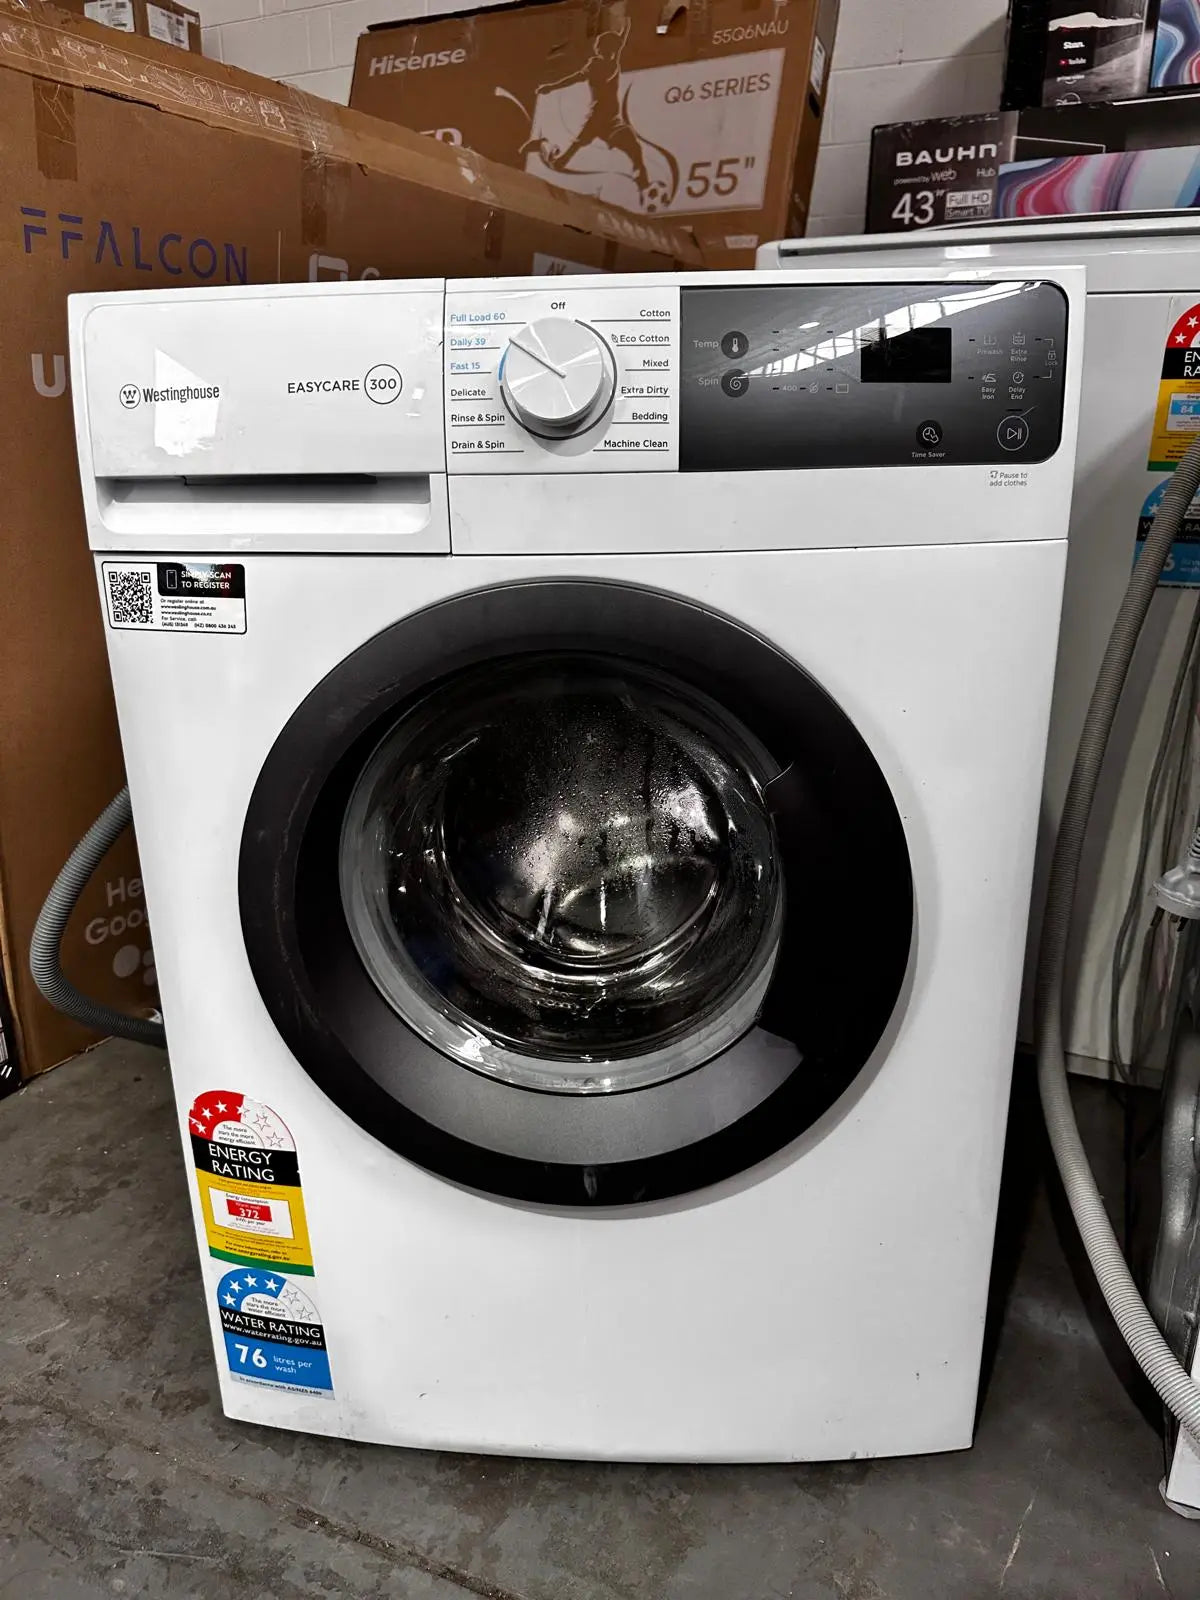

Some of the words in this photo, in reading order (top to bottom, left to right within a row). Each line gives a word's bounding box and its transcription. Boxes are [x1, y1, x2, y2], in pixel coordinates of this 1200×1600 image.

[712, 19, 790, 45] 55Q6NAU
[368, 48, 467, 77] Hisense
[664, 85, 696, 104] Q6
[700, 73, 771, 100] SERIES
[976, 167, 996, 177] Hub
[685, 156, 756, 199] 55"
[949, 194, 969, 206] Full
[972, 192, 989, 203] HD
[947, 208, 974, 218] Smart
[976, 206, 990, 216] TV
[20, 206, 249, 285] FFALCON
[550, 302, 566, 310] Off
[450, 314, 466, 322] Full
[468, 313, 491, 322] Load
[493, 312, 505, 320] 60
[640, 309, 671, 318] Cotton
[450, 338, 473, 347] Daily
[475, 338, 486, 346] 39
[620, 335, 638, 343] Eco
[639, 334, 670, 343] Cotton
[693, 340, 720, 349] Temp
[450, 362, 469, 370] Fast
[471, 362, 480, 370] 15
[643, 359, 669, 368] Mixed
[287, 379, 360, 394] EASYCARE
[370, 378, 397, 391] 300
[698, 377, 719, 386] Spin
[143, 385, 220, 403] Westinghouse
[450, 388, 486, 397] Delicate
[621, 387, 645, 395] Extra
[647, 386, 669, 396] Dirty
[981, 387, 996, 395] Easy
[1008, 386, 1026, 394] Delay
[451, 414, 476, 422] Rinse
[477, 414, 484, 422] &
[485, 413, 505, 424] Spin
[632, 413, 668, 423] Bedding
[451, 441, 477, 449] Drain
[479, 441, 484, 449] &
[485, 441, 505, 451] Spin
[604, 440, 645, 449] Machine
[646, 440, 668, 449] Clean
[1000, 472, 1019, 480] Pause
[210, 571, 232, 579] SCAN
[85, 907, 150, 945] Goo
[208, 1142, 272, 1165] ENERGY
[211, 1159, 275, 1182] RATING
[225, 1193, 240, 1201] Energy
[241, 1196, 269, 1204] consumption
[239, 1208, 260, 1219] 372
[264, 1310, 286, 1318] efficient
[220, 1309, 266, 1330] WATER
[269, 1321, 320, 1338] RATING
[223, 1322, 322, 1346] www.waterrating.gov.au
[234, 1343, 267, 1368] 76
[273, 1355, 295, 1366] litres
[297, 1359, 312, 1368] per
[275, 1365, 297, 1374] wash
